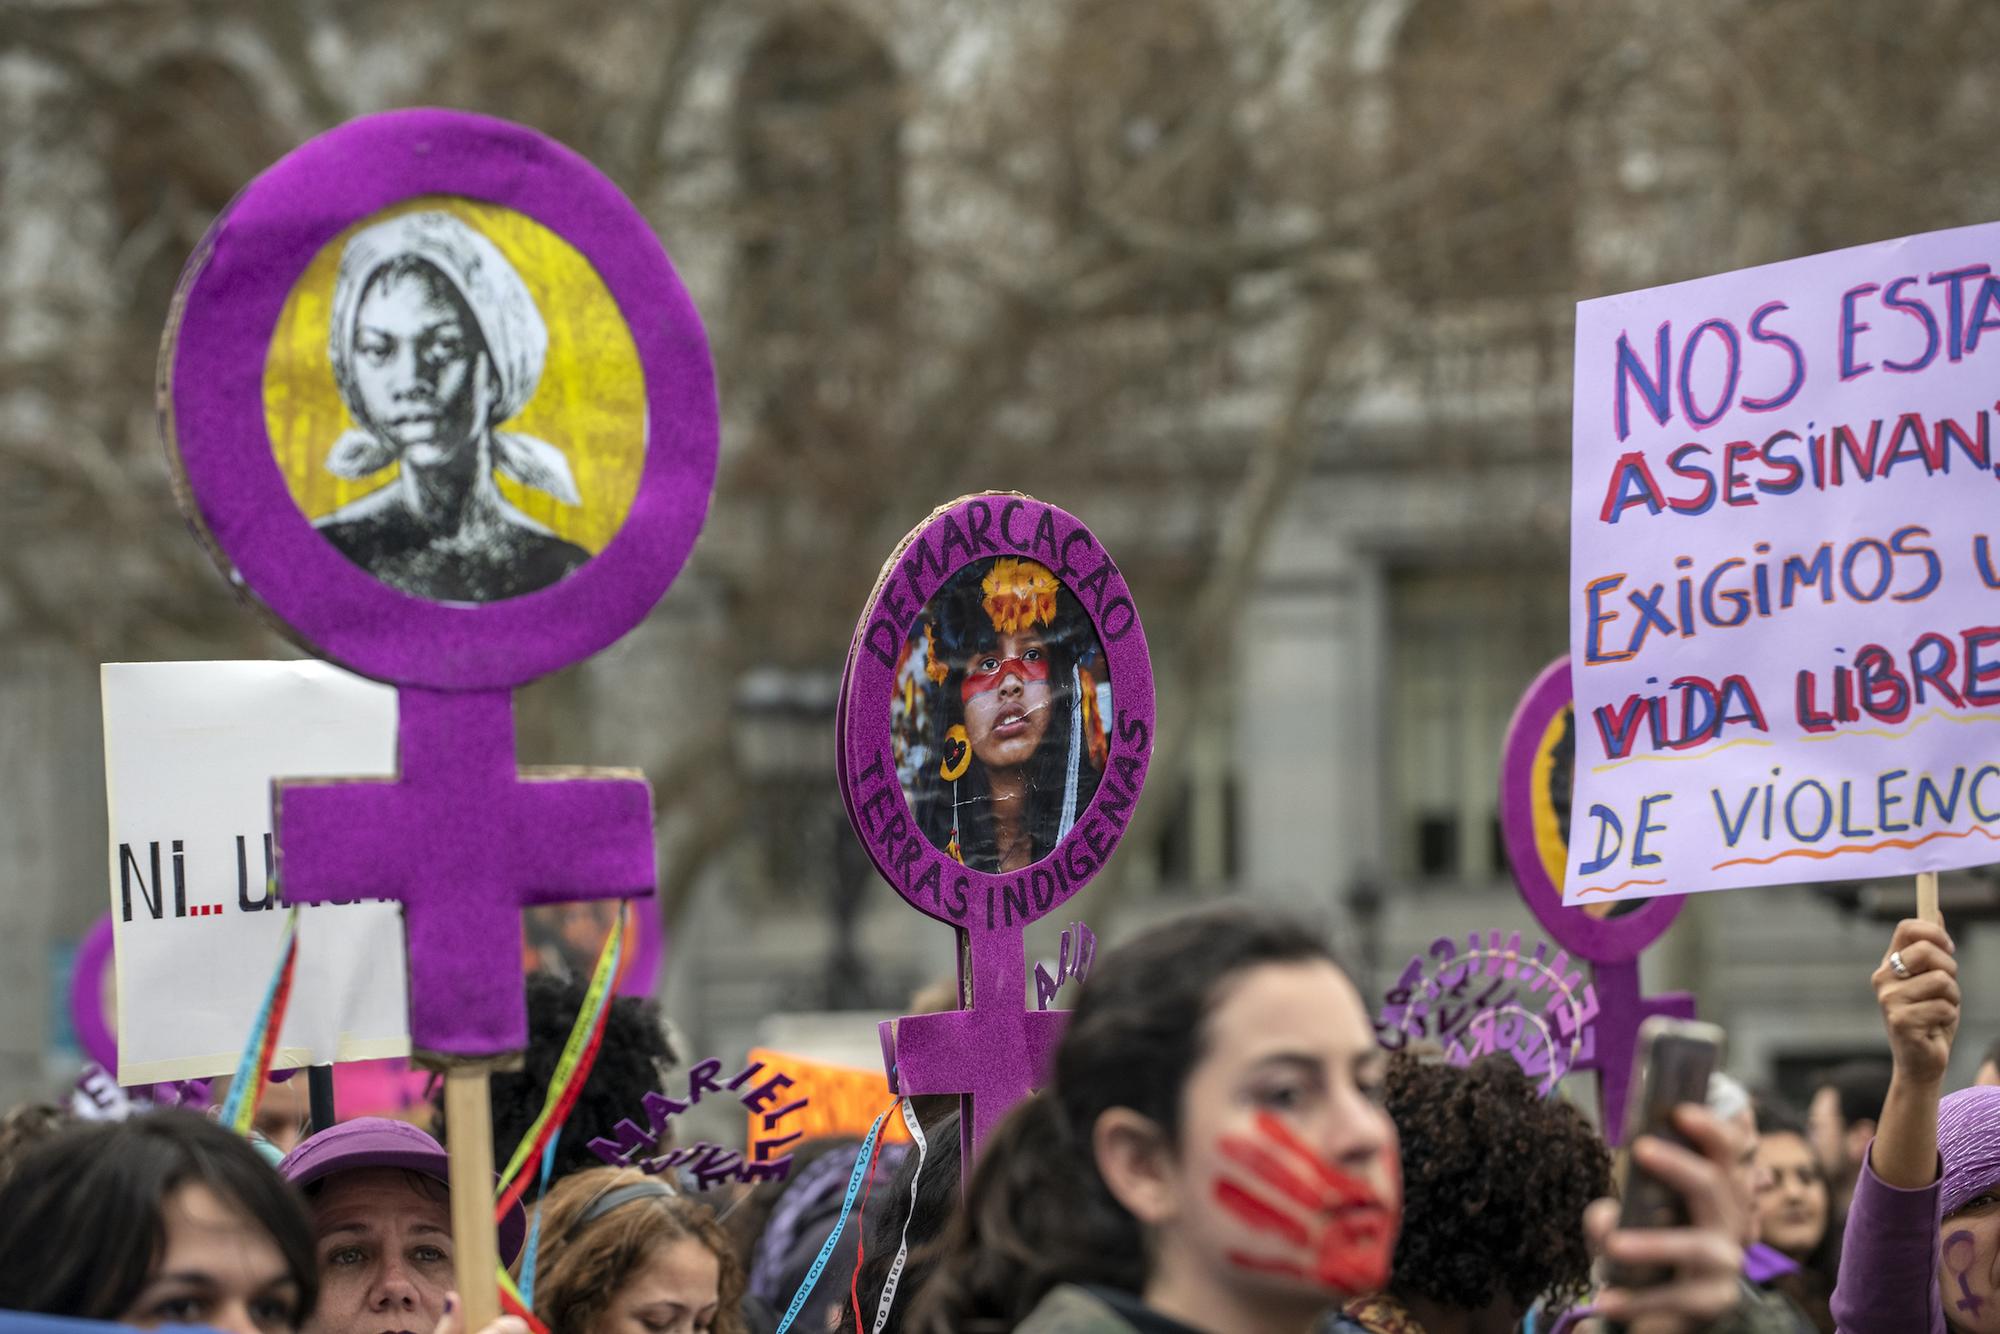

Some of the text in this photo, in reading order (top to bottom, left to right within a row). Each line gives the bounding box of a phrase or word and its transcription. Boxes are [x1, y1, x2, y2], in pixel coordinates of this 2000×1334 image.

[1614, 301, 1806, 442] NOS
[861, 709, 1148, 930] TERRAS INDIGENAS
[1578, 794, 1672, 875] DE
[850, 1171, 861, 1193] DO
[810, 1261, 824, 1279] DO
[876, 1248, 906, 1328] DO SENHOR
